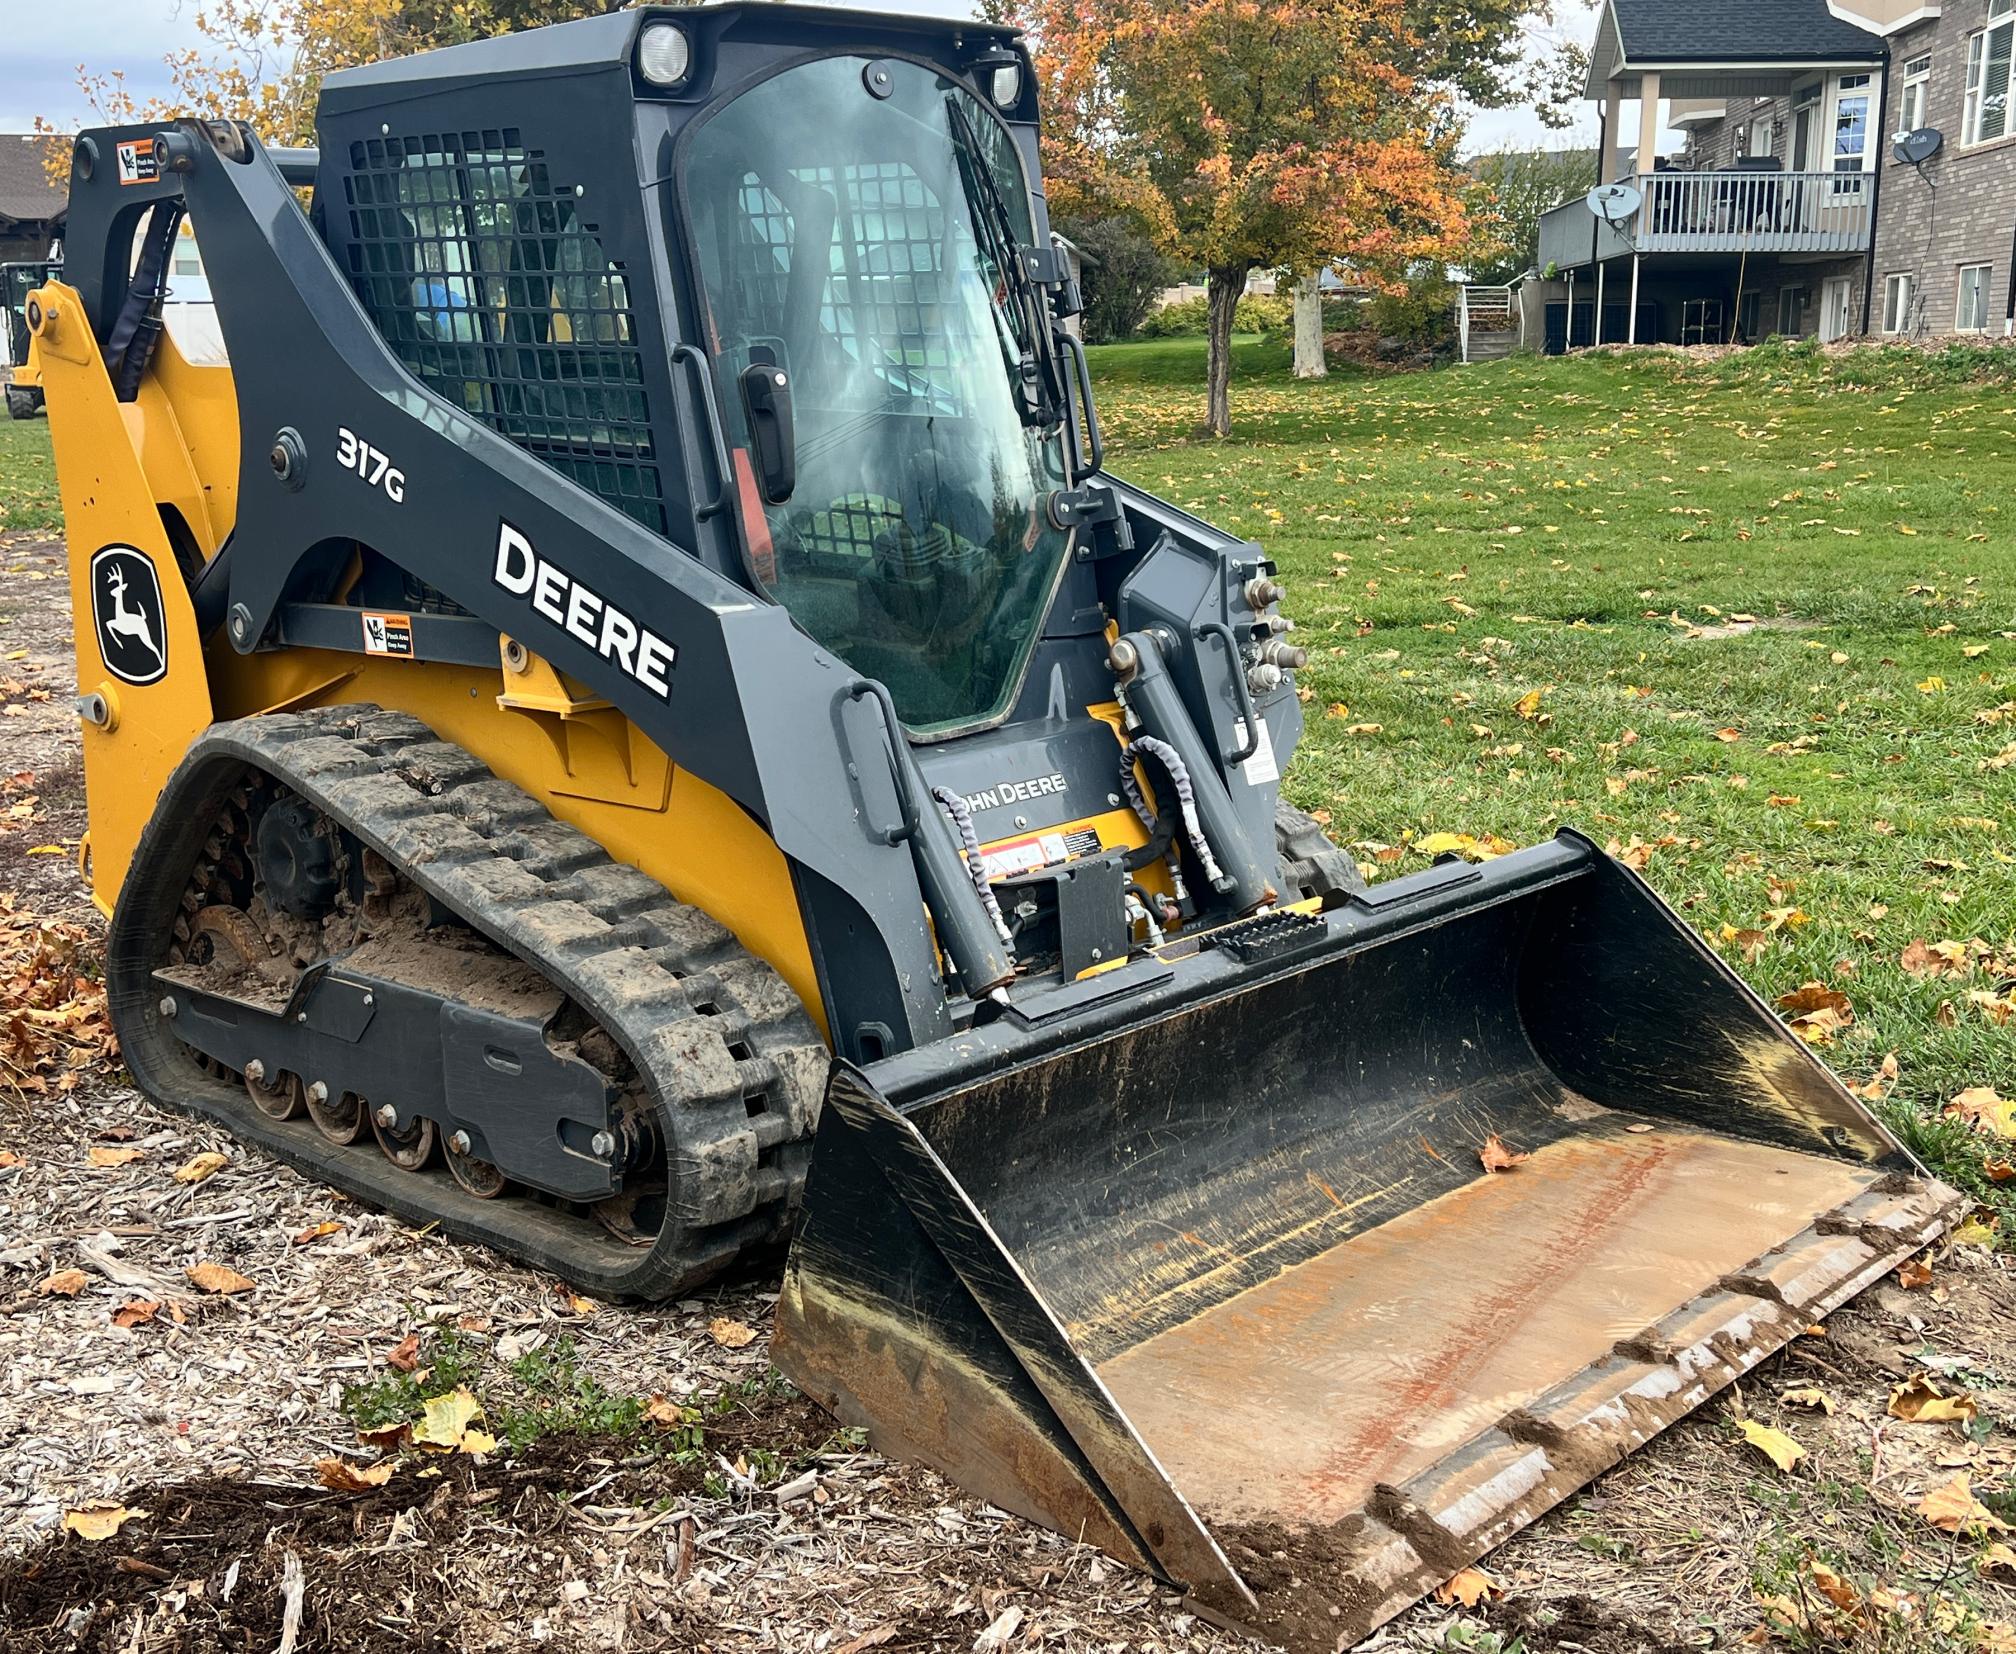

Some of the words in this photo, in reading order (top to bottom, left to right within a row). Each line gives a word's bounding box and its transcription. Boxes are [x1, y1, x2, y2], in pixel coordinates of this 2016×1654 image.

[336, 427, 406, 503] 317G
[495, 523, 675, 698] DEERE
[997, 774, 1067, 805] DEERE
